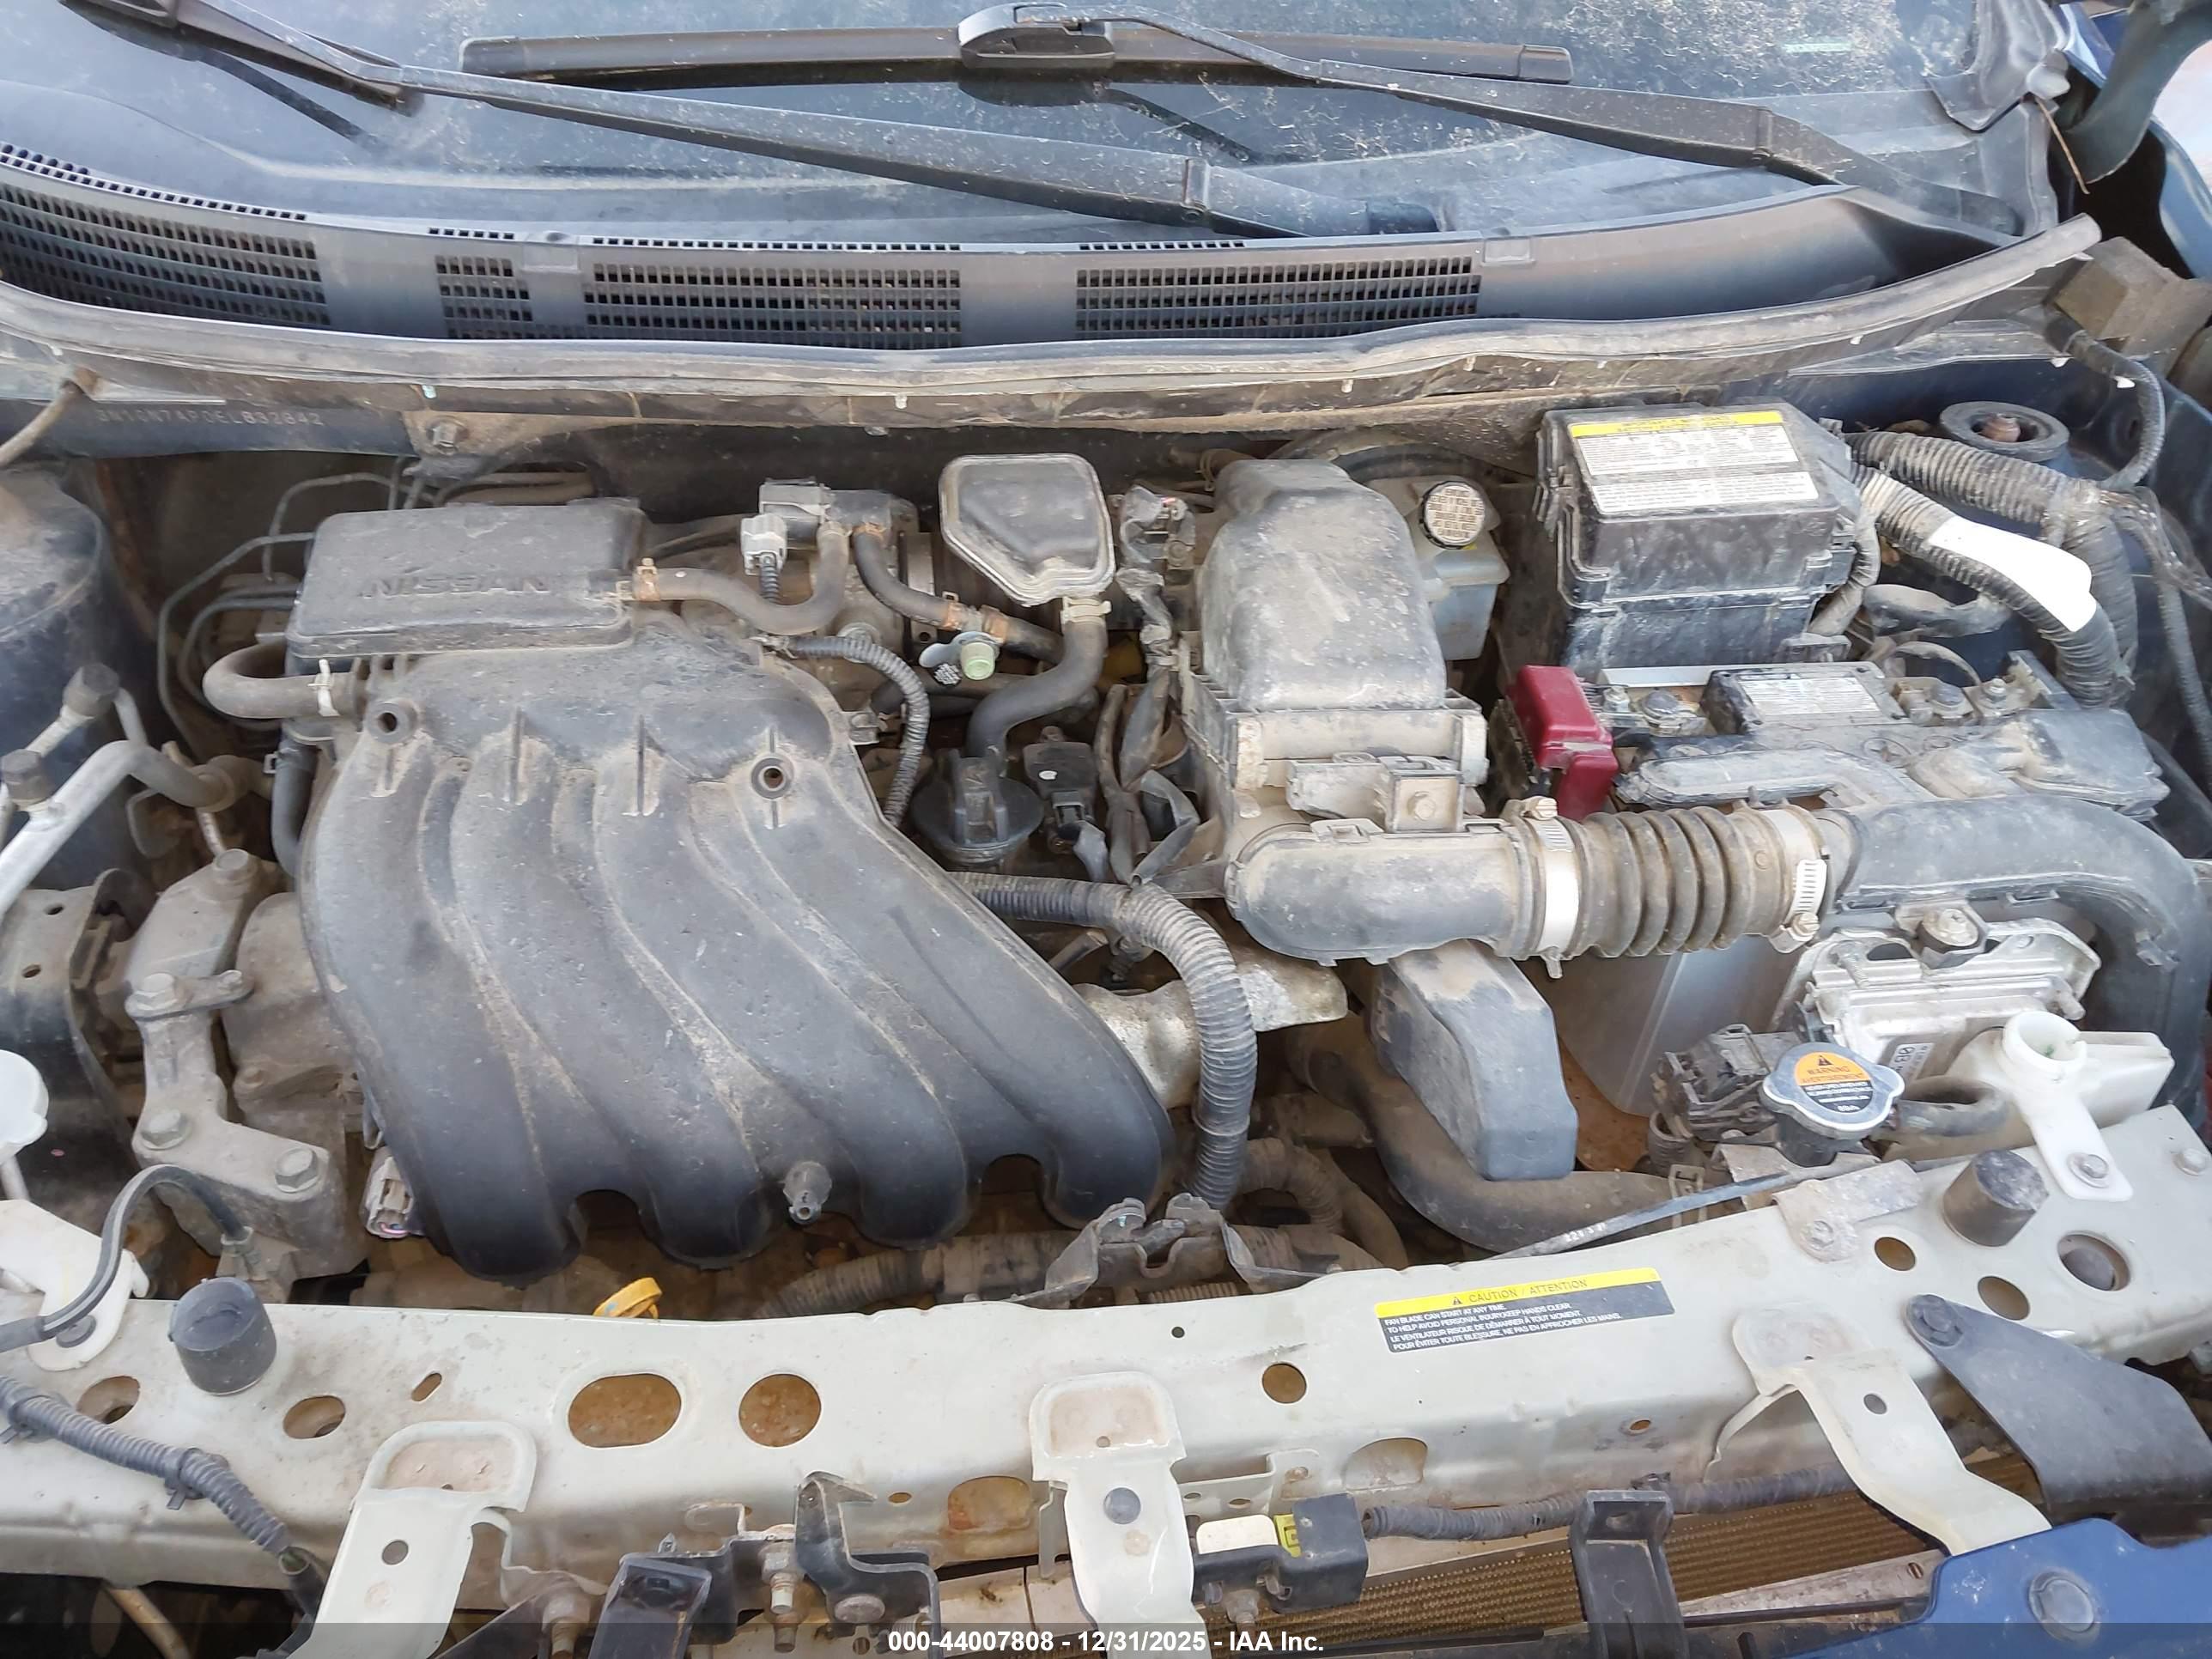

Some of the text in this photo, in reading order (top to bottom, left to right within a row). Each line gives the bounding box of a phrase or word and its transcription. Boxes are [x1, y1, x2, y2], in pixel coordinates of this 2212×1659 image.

[358, 574, 551, 599] NISSAN
[1468, 1289, 1518, 1303] CAUTION
[1529, 1279, 1588, 1295] ATTENTION
[1400, 1315, 1424, 1323] BLADE
[1440, 1310, 1462, 1318] START
[1401, 1329, 1447, 1341] VENTILATEUR
[1446, 1325, 1474, 1335] RISQUE
[1530, 1315, 1549, 1323] TOUT
[1419, 1321, 1440, 1329] AVOID
[1440, 1316, 1479, 1326] PERSONAL
[1521, 1305, 1547, 1315] HANDS
[1440, 1335, 1464, 1344] TOUTE
[1540, 1318, 1584, 1329] APPROCHER
